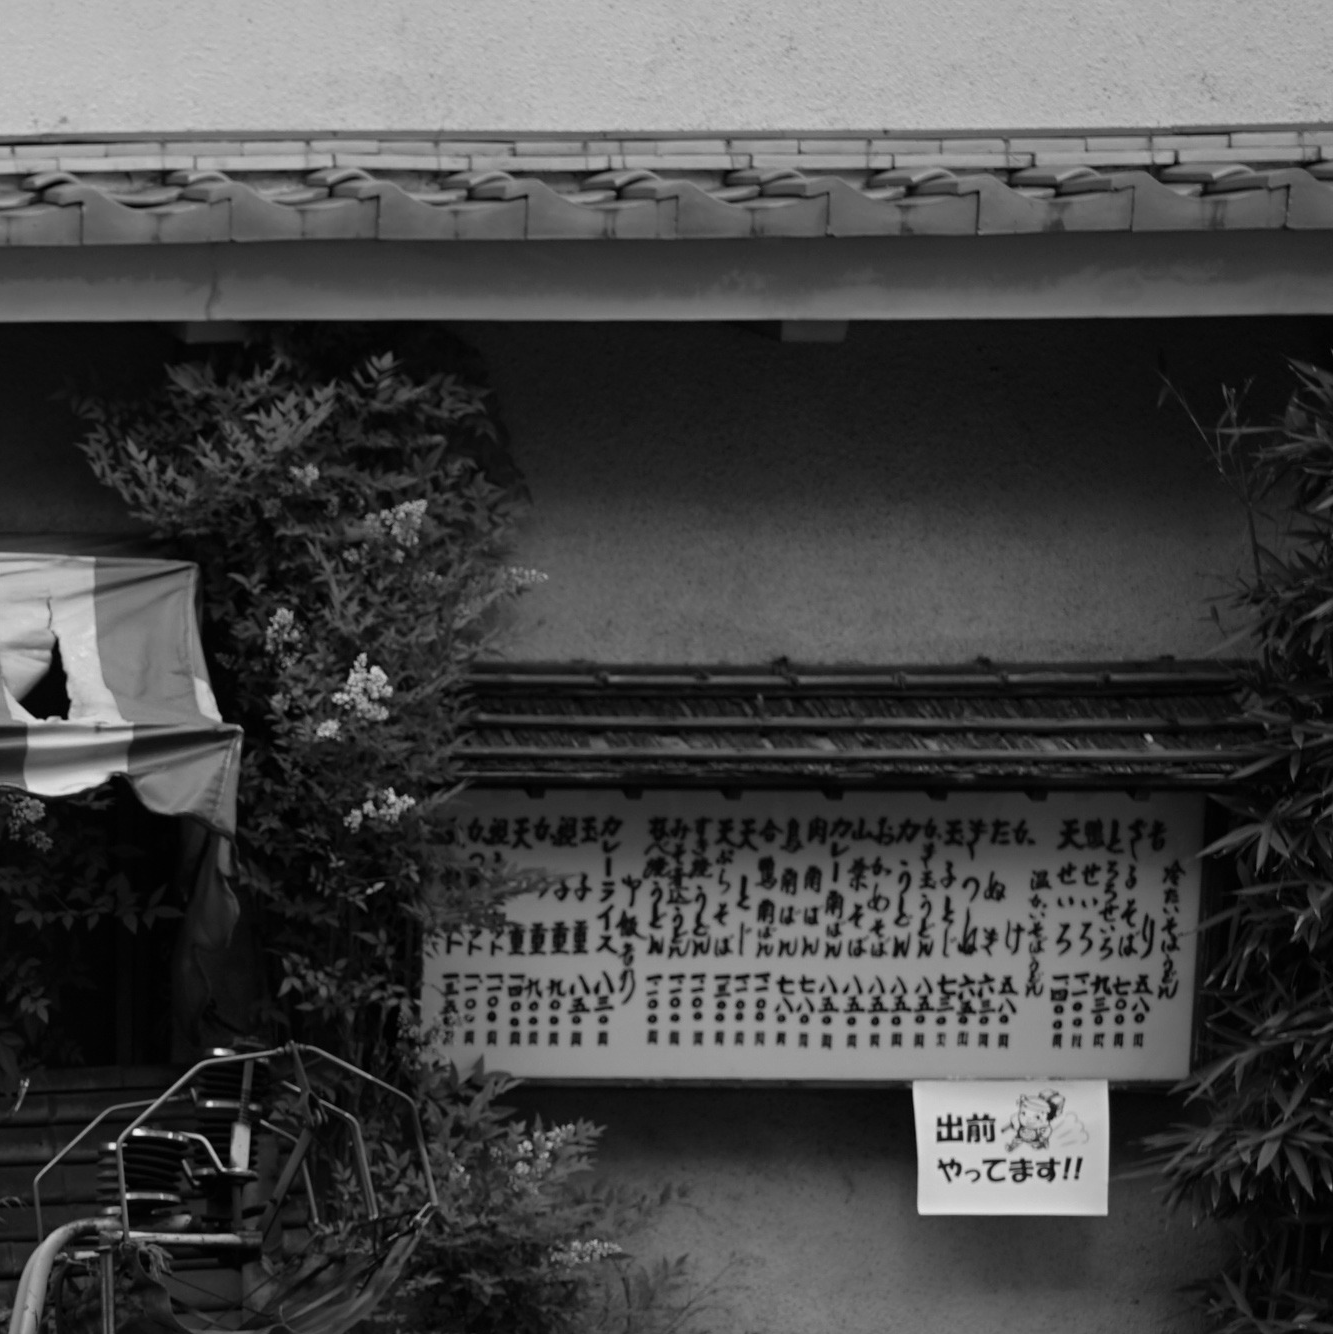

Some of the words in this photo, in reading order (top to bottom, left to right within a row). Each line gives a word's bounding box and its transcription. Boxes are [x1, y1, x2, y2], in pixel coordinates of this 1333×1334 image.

[597, 816, 623, 956] カレーライス
[936, 1114, 995, 1143] 出前
